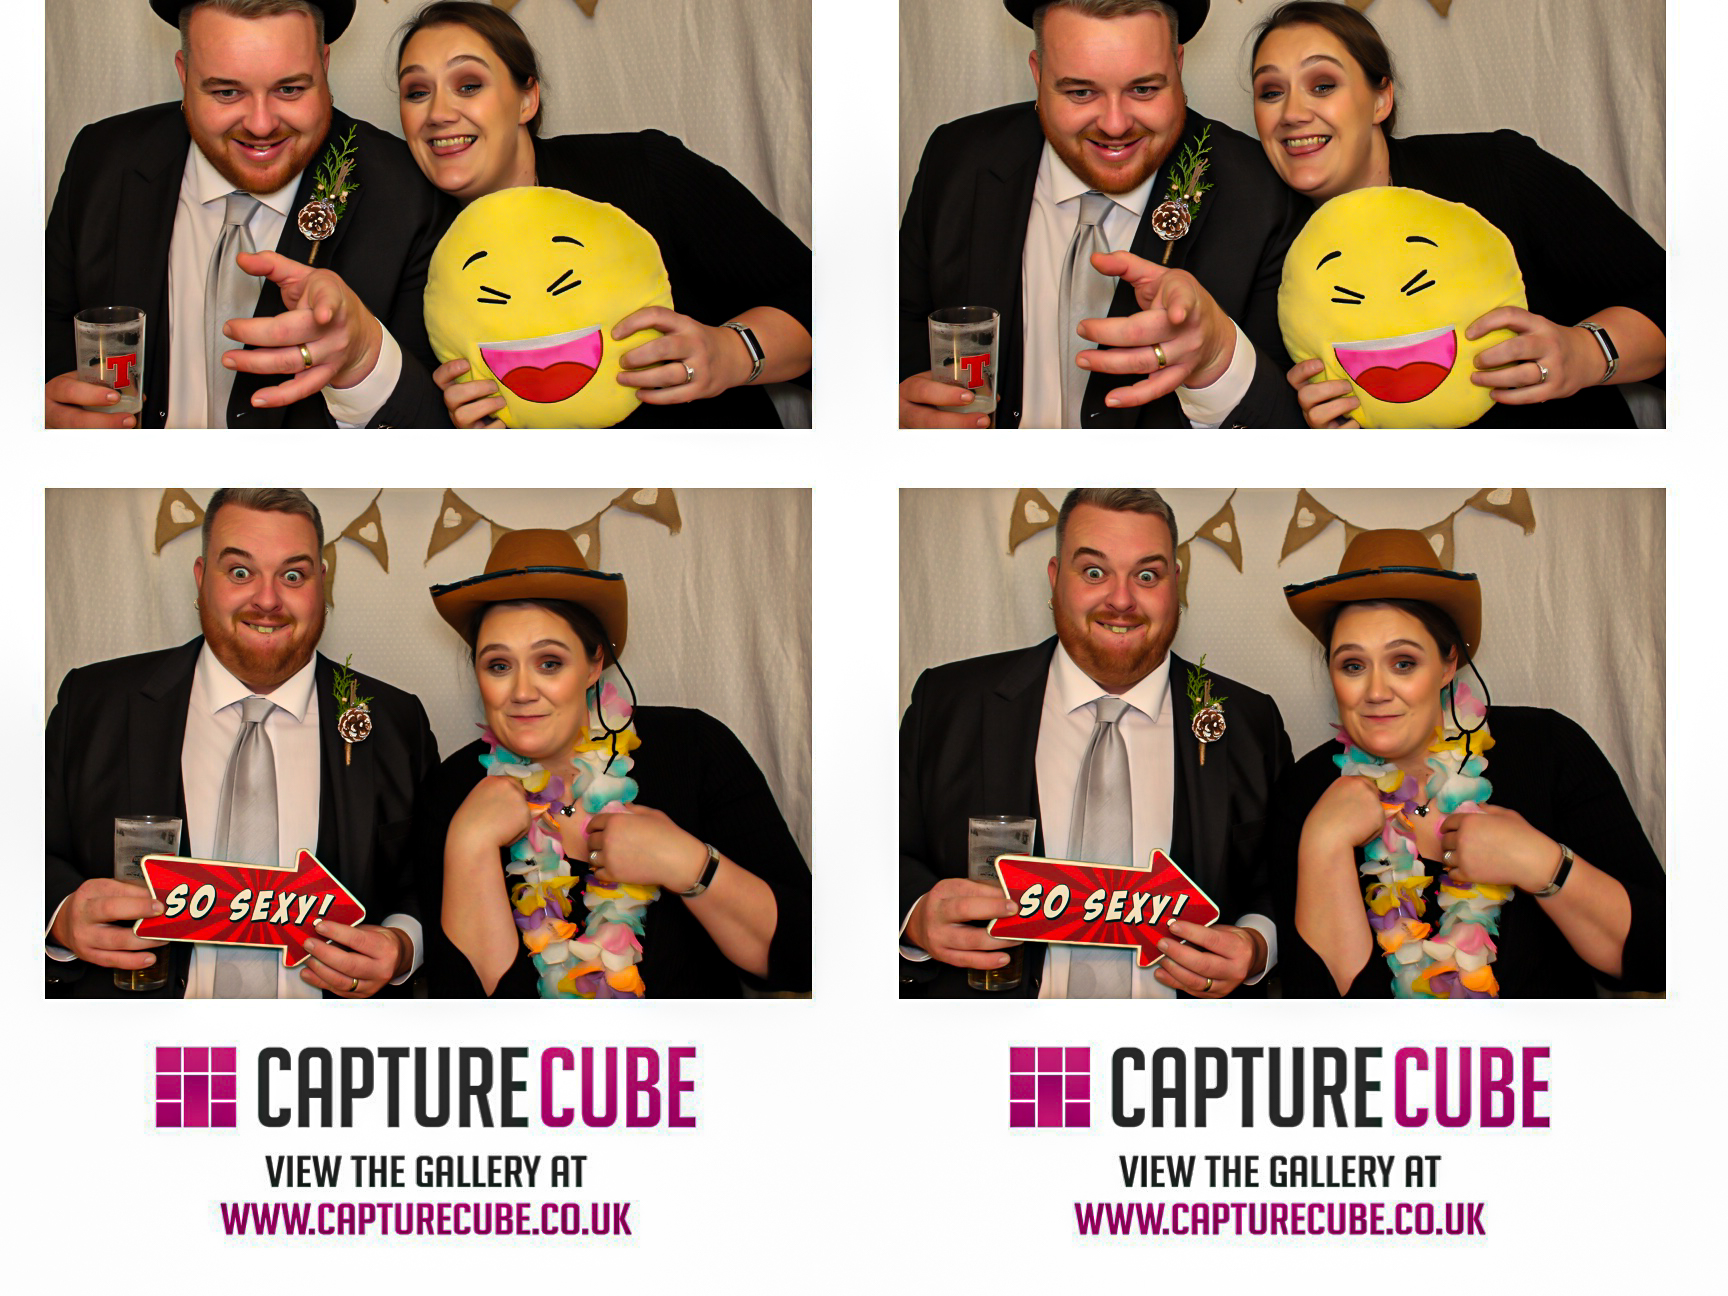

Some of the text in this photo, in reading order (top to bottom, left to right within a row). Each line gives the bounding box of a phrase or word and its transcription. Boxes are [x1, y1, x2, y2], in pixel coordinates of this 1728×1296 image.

[106, 353, 137, 389] T
[960, 353, 991, 389] T
[165, 883, 336, 927] SO SEXY!
[1019, 883, 1190, 927] SO SEXY!
